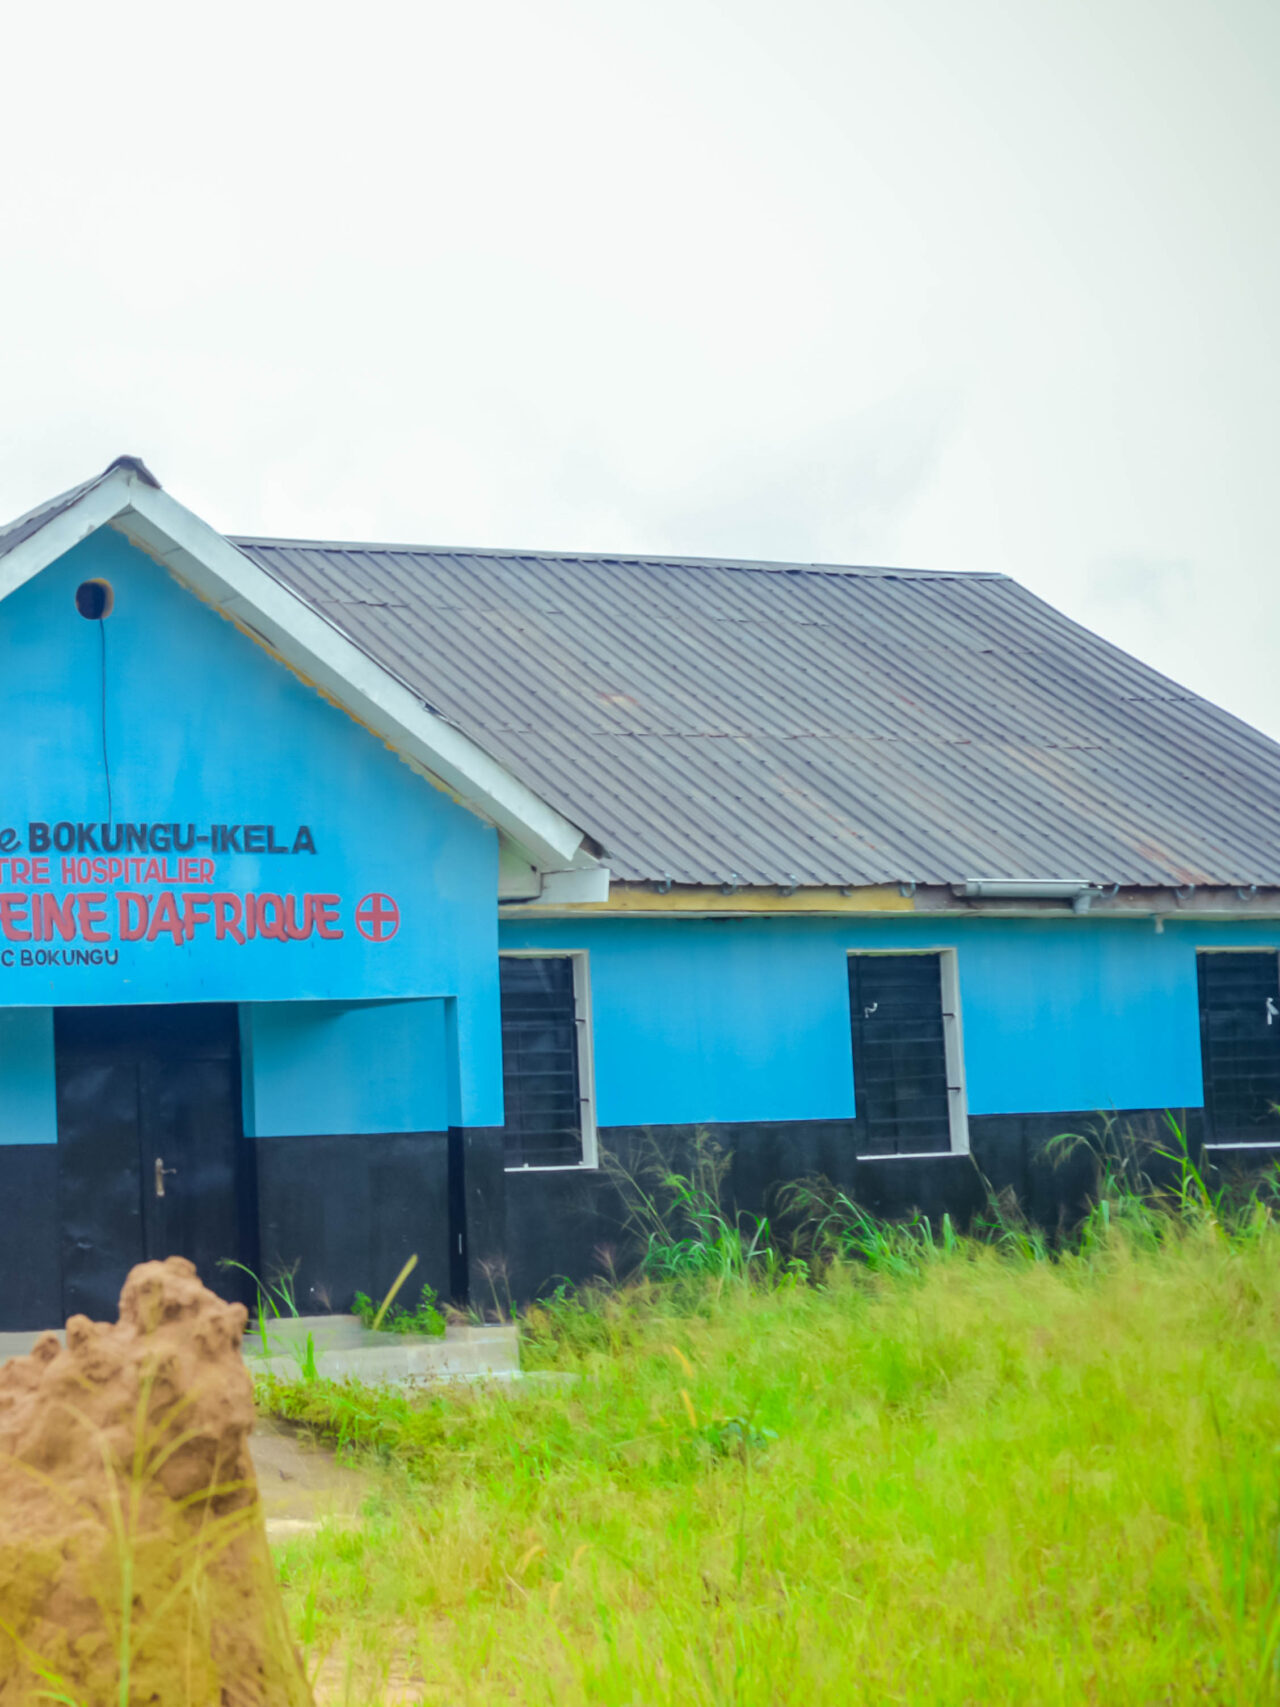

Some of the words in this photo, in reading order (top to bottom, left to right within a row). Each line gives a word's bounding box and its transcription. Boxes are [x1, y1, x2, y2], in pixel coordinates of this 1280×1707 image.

[28, 821, 317, 855] BOKUNGU-IKELA
[61, 857, 216, 885] HOSPITALIER
[115, 891, 344, 946] D'AFRIQUE
[20, 949, 119, 967] BOKUNGU
